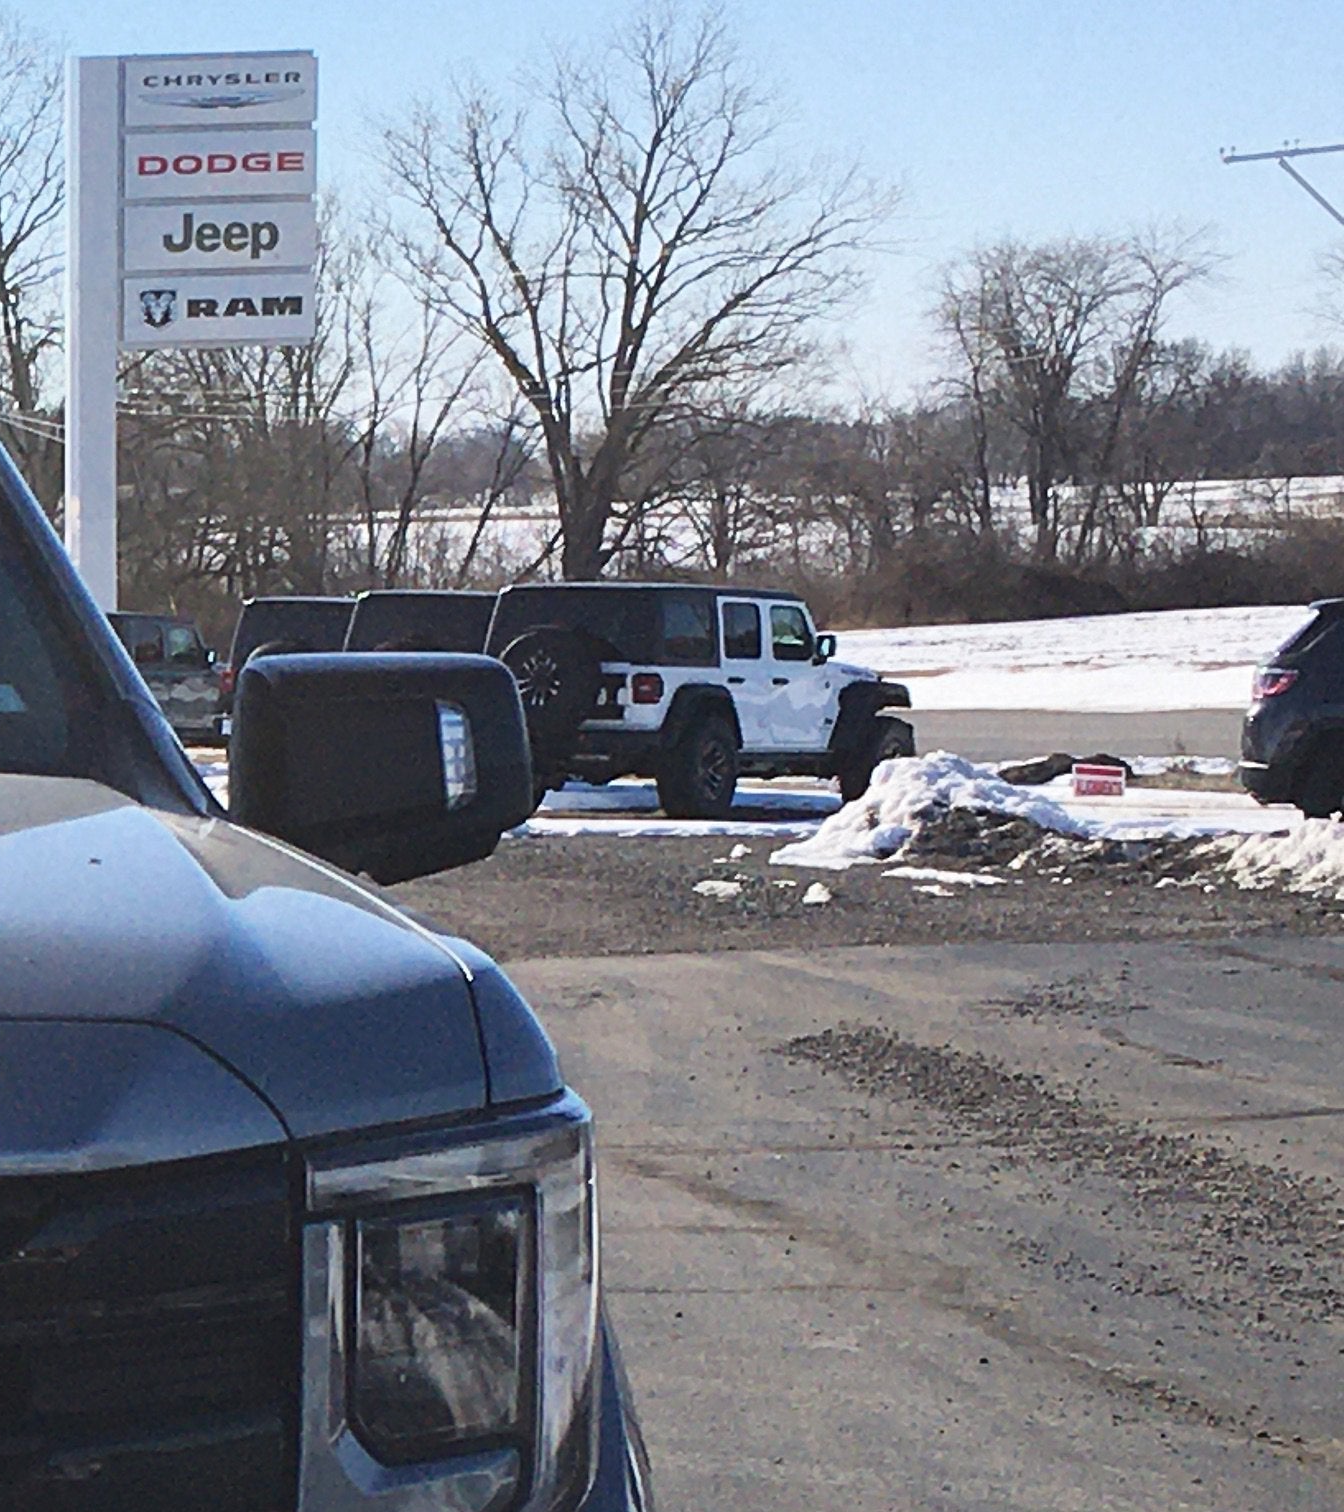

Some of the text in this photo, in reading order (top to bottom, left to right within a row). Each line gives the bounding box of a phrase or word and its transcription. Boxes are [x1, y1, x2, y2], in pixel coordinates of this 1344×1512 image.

[142, 71, 302, 88] CHRYSLER
[137, 151, 306, 176] DODGE
[162, 212, 280, 260] Jeep
[186, 295, 304, 319] RAM
